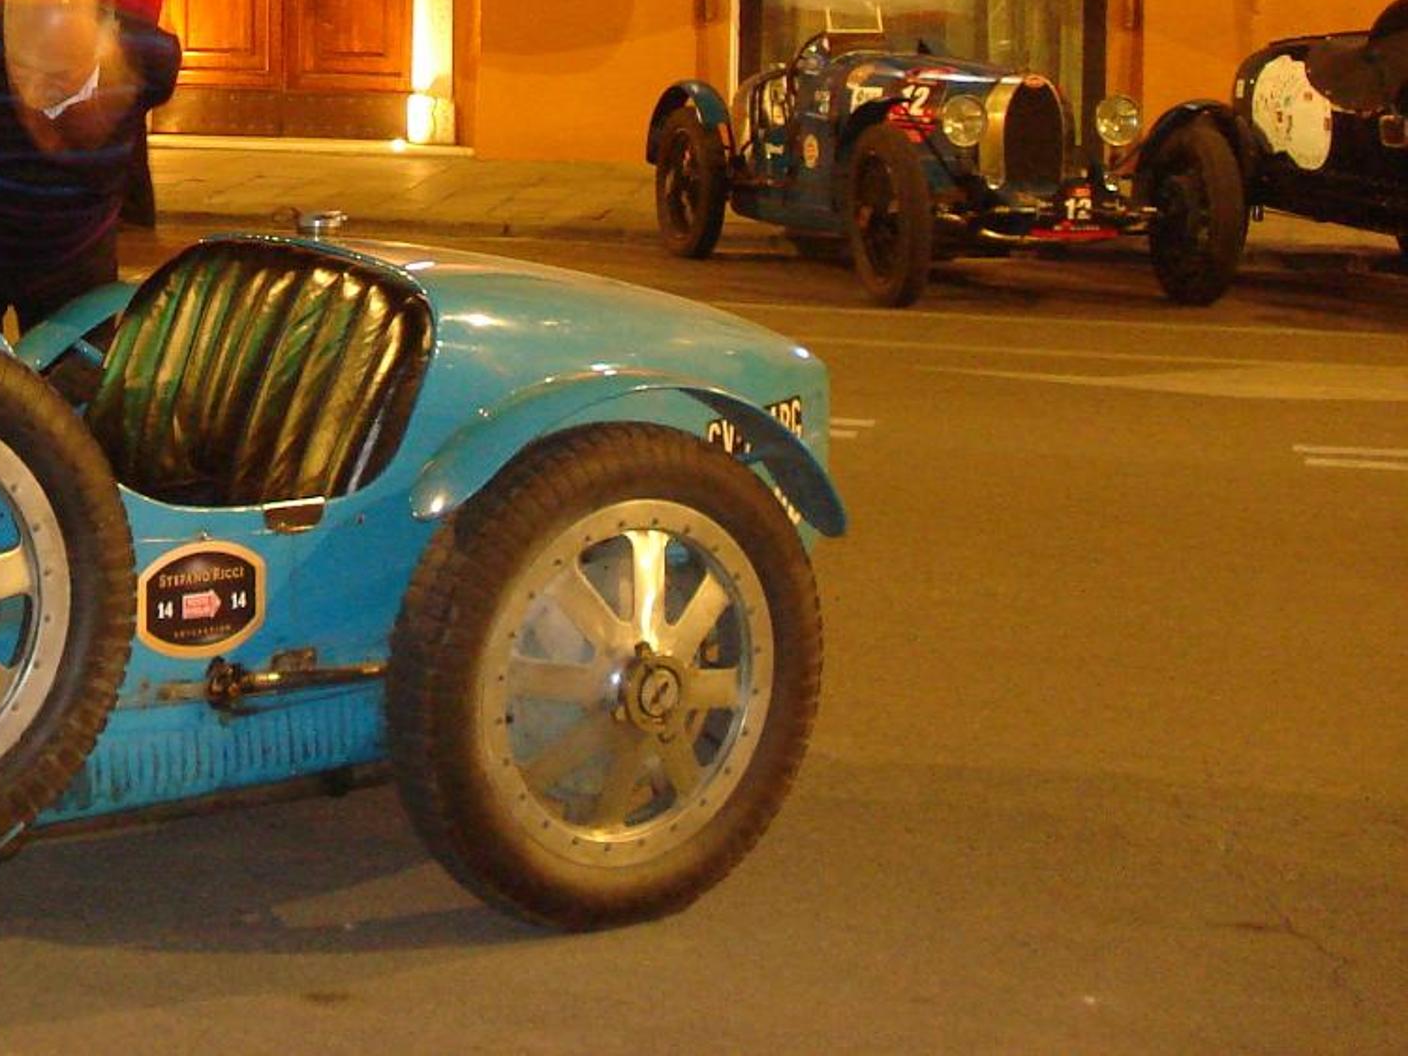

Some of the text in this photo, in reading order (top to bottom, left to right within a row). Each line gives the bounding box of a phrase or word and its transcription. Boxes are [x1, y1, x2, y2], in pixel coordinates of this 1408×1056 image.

[1064, 198, 1092, 220] 12
[230, 591, 247, 609] 14
[157, 602, 173, 619] 14
